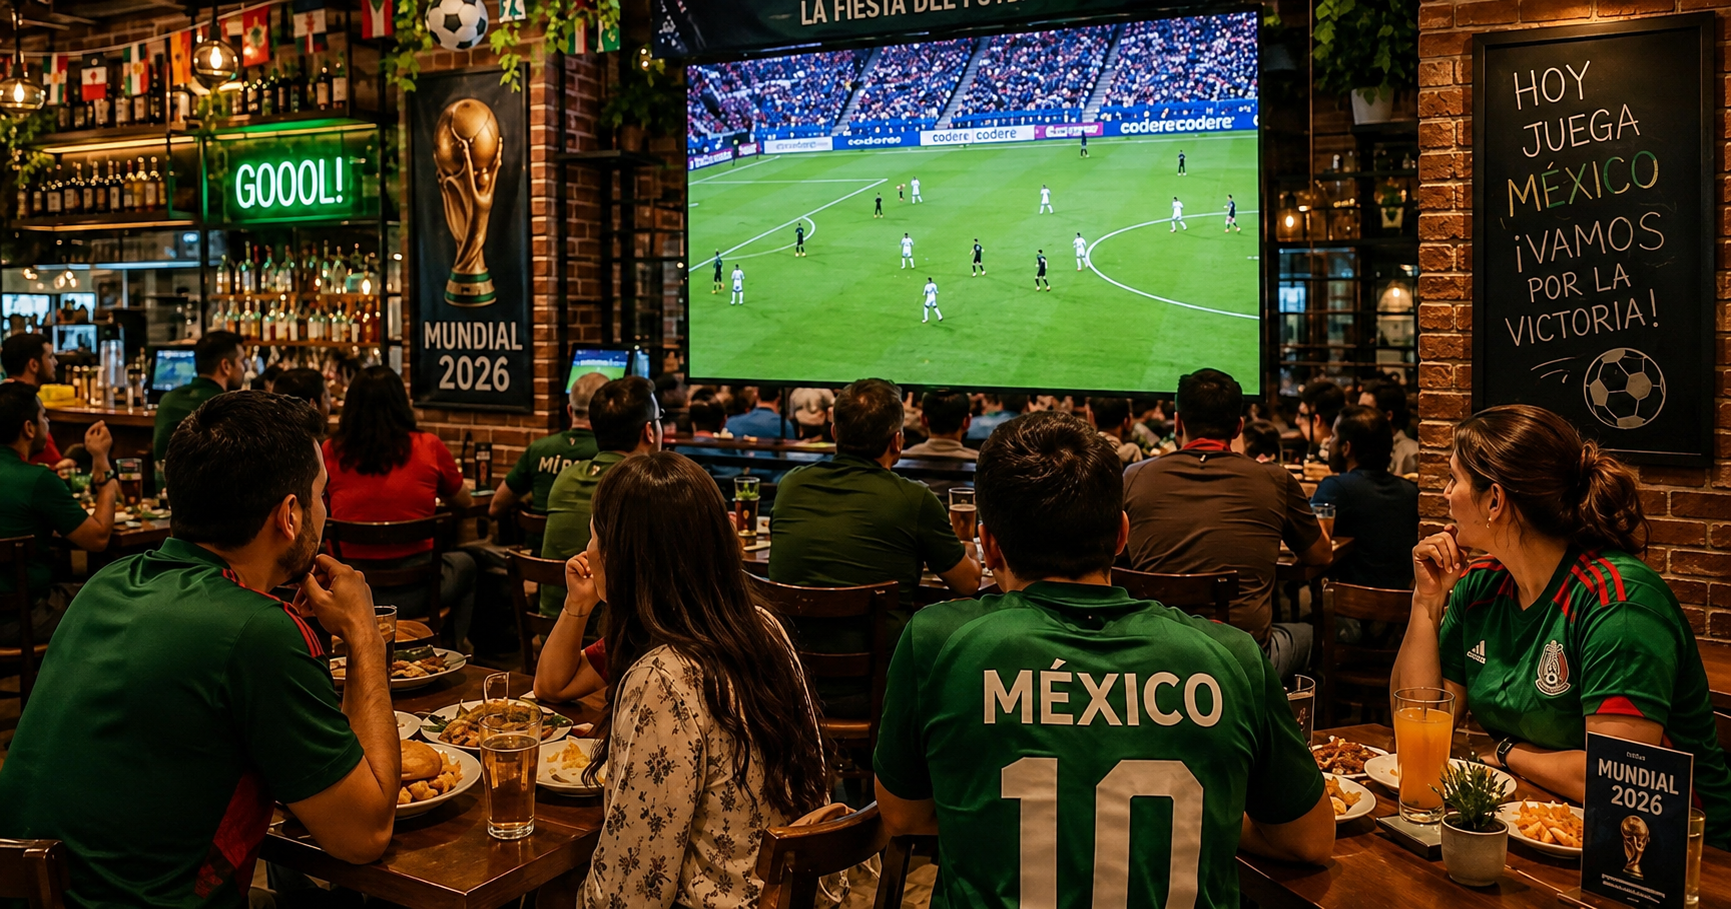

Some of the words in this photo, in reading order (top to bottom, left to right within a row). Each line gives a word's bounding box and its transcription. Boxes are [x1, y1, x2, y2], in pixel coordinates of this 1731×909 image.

[802, 0, 828, 26] LA
[834, 0, 907, 22] FIESTA
[1513, 60, 1591, 111] HOY
[975, 129, 1017, 140] codere
[1522, 103, 1641, 158] JUEGA
[235, 156, 343, 209] GOOOL!
[1507, 150, 1659, 218] MÉXICO
[1514, 211, 1665, 273] ¡VAMOS
[1527, 271, 1583, 303] POR
[1593, 262, 1632, 293] LA
[424, 321, 523, 351] MUNDIAL
[1504, 288, 1660, 347] VICTORIA!
[439, 355, 510, 392] 2026
[983, 658, 1224, 728] MÉXICO
[1598, 758, 1679, 796] MUNDIAL
[1611, 784, 1663, 816] 2026
[1000, 756, 1204, 909] 10
